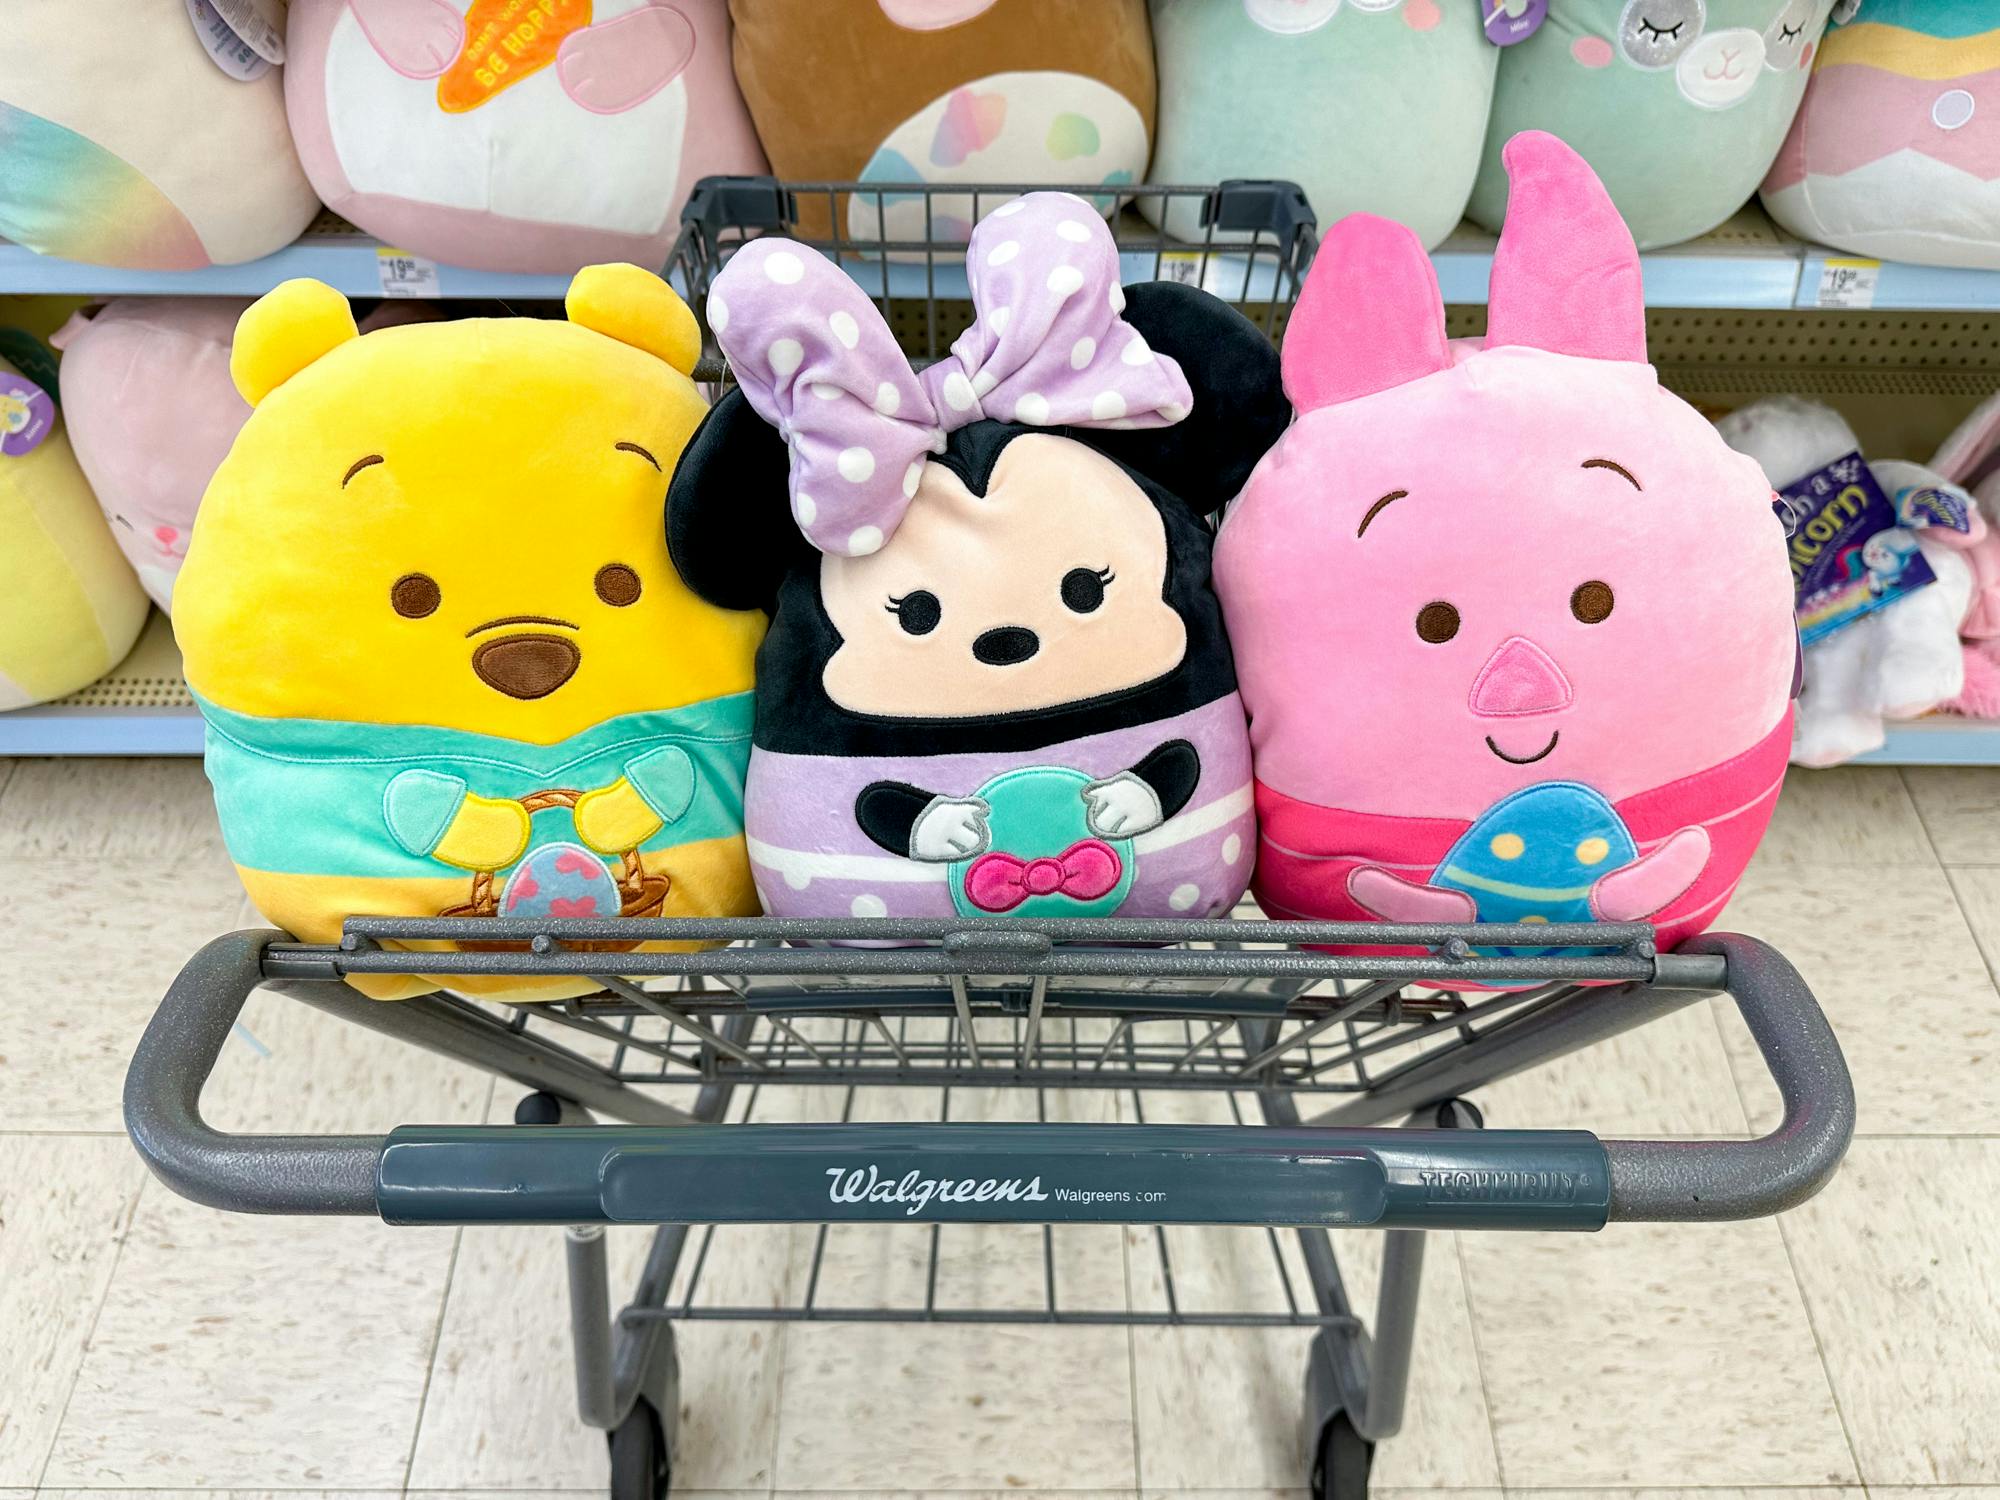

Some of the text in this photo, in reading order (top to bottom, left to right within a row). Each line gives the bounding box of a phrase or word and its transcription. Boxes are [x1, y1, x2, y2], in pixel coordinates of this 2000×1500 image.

[473, 0, 568, 87] BE HOPP
[825, 1165, 1048, 1215] Walgreens
